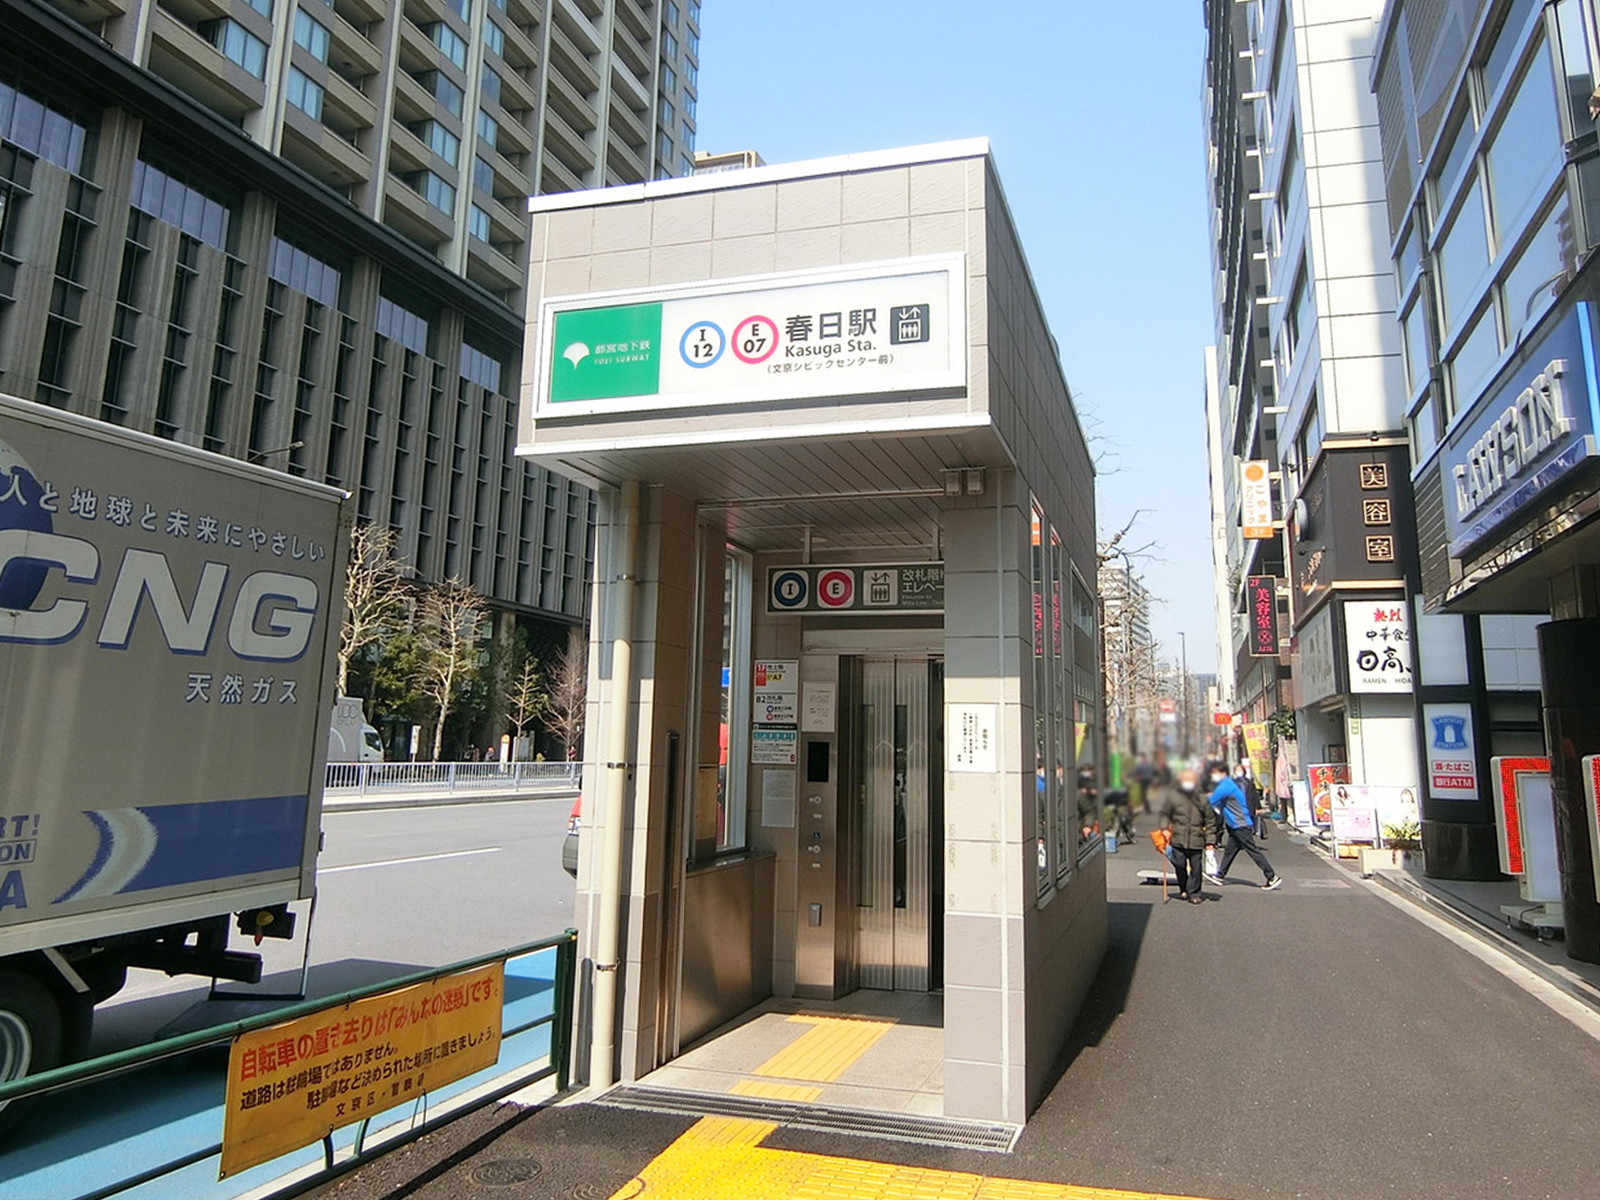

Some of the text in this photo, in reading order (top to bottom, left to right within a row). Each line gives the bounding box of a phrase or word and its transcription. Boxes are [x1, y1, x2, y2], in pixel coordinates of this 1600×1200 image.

[752, 324, 760, 337] E
[785, 307, 877, 343] 春日駅
[699, 329, 706, 342] I
[693, 344, 713, 358] 12
[744, 339, 766, 354] 07
[785, 339, 877, 359] Kasuga Sta.
[1452, 358, 1576, 523] LAWSON
[0, 474, 326, 562] 人と地球と未来にやさしい
[1362, 465, 1393, 559] 美容室
[0, 528, 321, 663] CNG
[787, 582, 794, 596] I
[832, 582, 840, 595] E
[1255, 587, 1271, 629] 美容室
[1356, 645, 1412, 674] 日高
[186, 672, 299, 705] 天然ガス
[756, 695, 767, 703] B2
[1435, 777, 1473, 788] 銀行ATM
